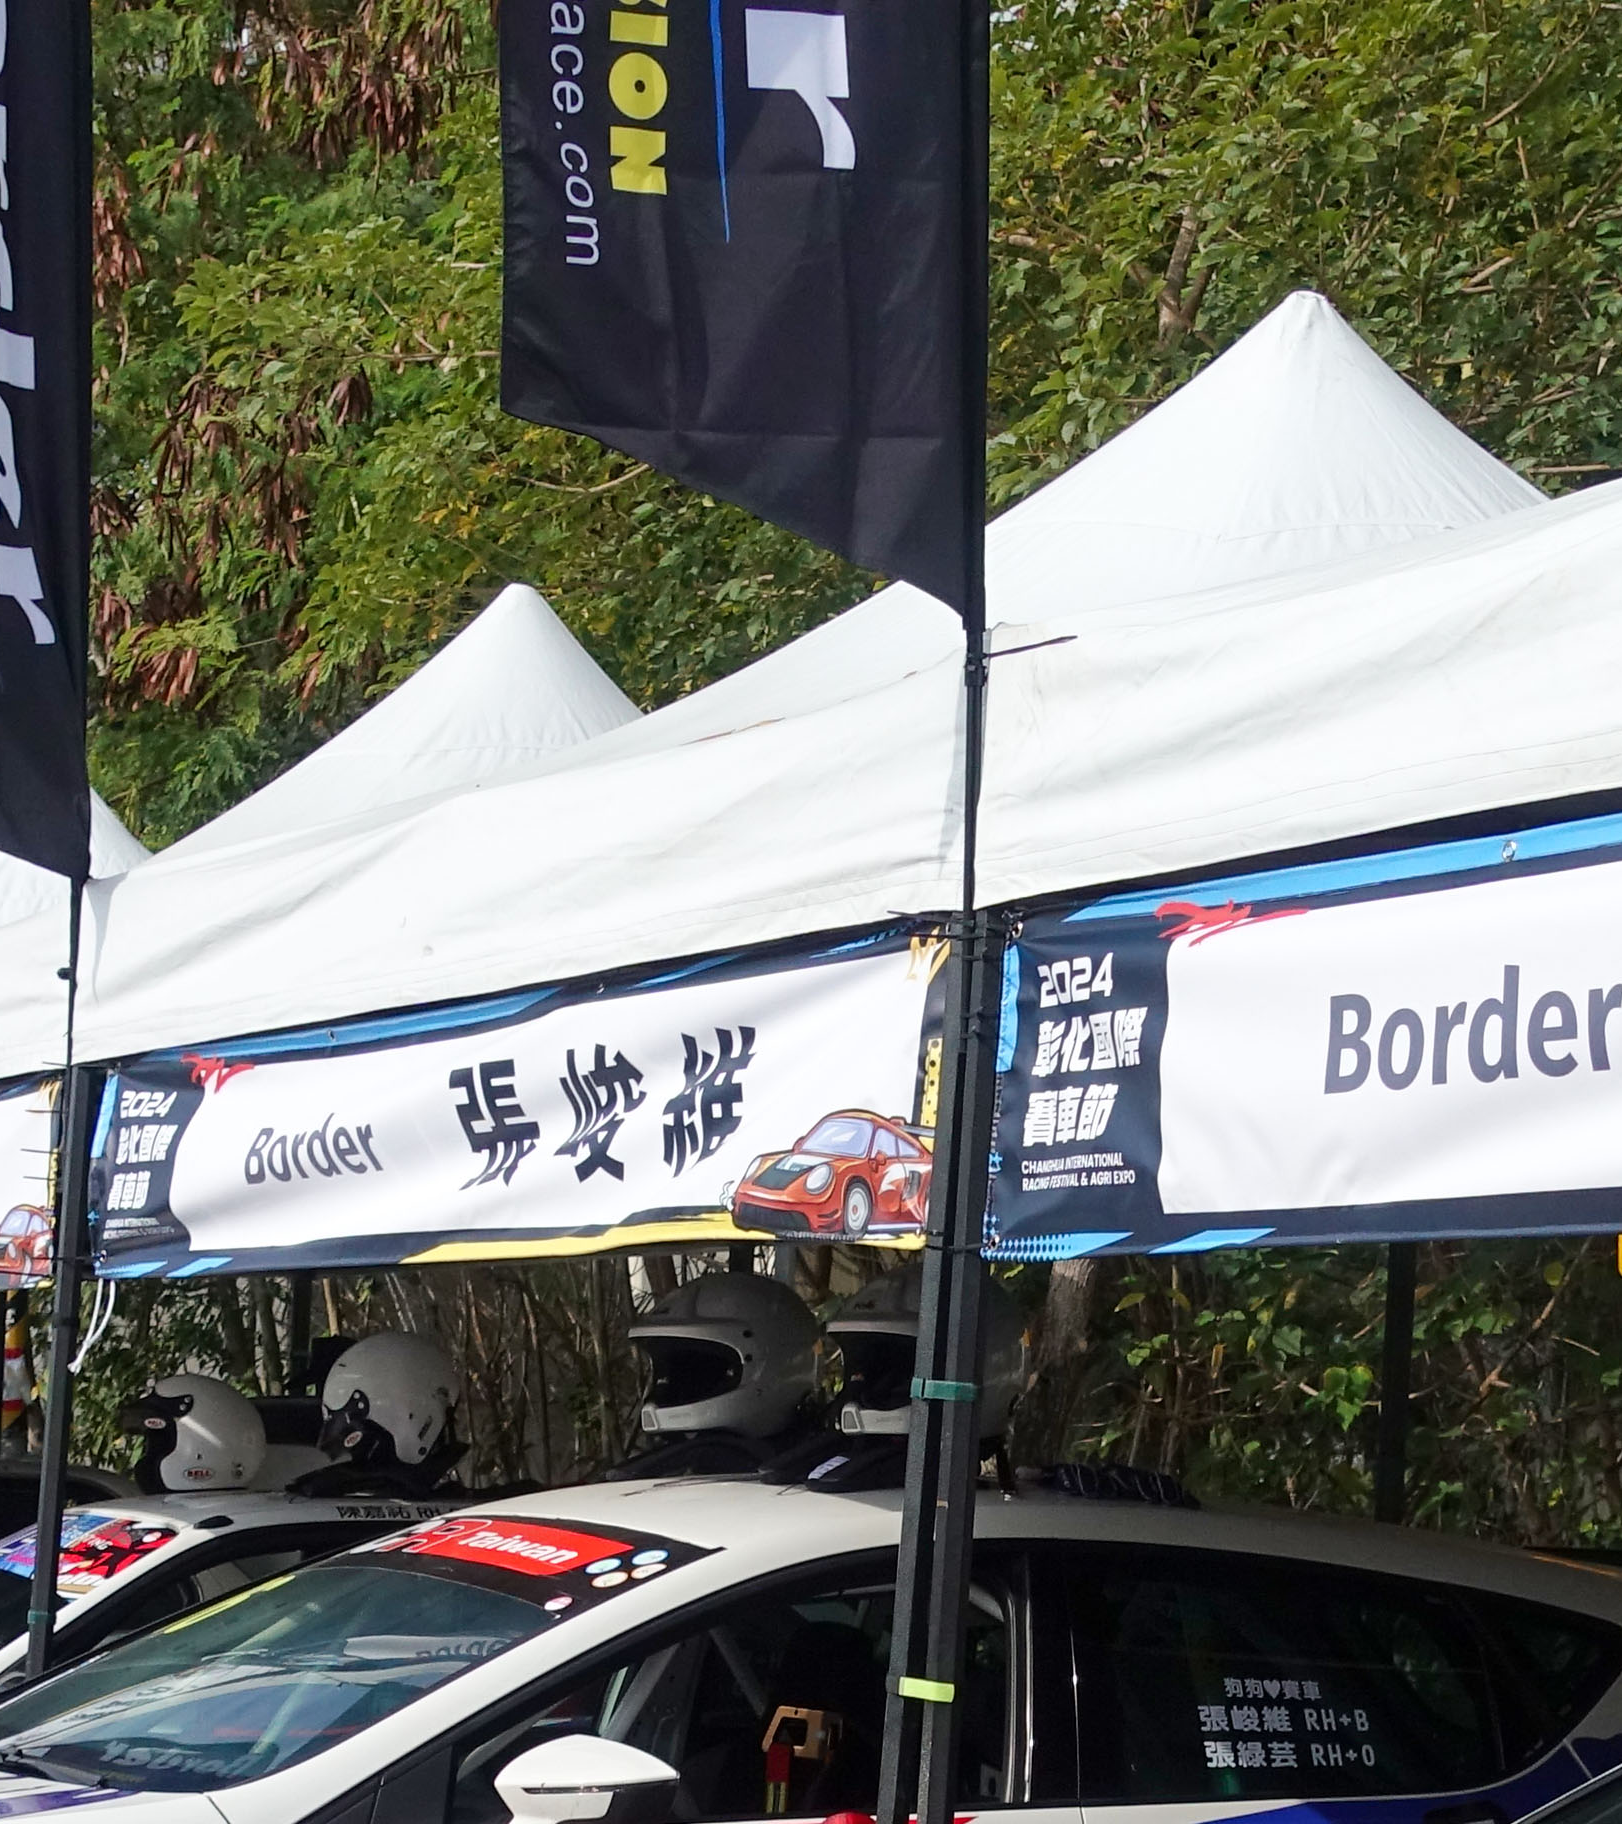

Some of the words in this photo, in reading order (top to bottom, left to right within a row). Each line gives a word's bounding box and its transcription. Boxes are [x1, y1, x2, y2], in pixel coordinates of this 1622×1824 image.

[609, 0, 668, 195] ION
[1037, 952, 1114, 1008] 2024
[1031, 1007, 1148, 1077] 彰化國際
[120, 1090, 177, 1119] 2024
[449, 1024, 758, 1193] 張峻維
[1023, 1083, 1119, 1147] 賽車節
[243, 1112, 377, 1188] Border
[1021, 1158, 1064, 1174] CHANGHUA
[1065, 1152, 1124, 1170] INTERNATIONAL
[1022, 1176, 1050, 1191] RACING
[1049, 1173, 1079, 1189] FESTIVAL
[1080, 1172, 1088, 1186] &
[1090, 1170, 1112, 1185] AGRI
[1114, 1169, 1136, 1185] EXPO
[458, 1531, 578, 1564] Taiwan
